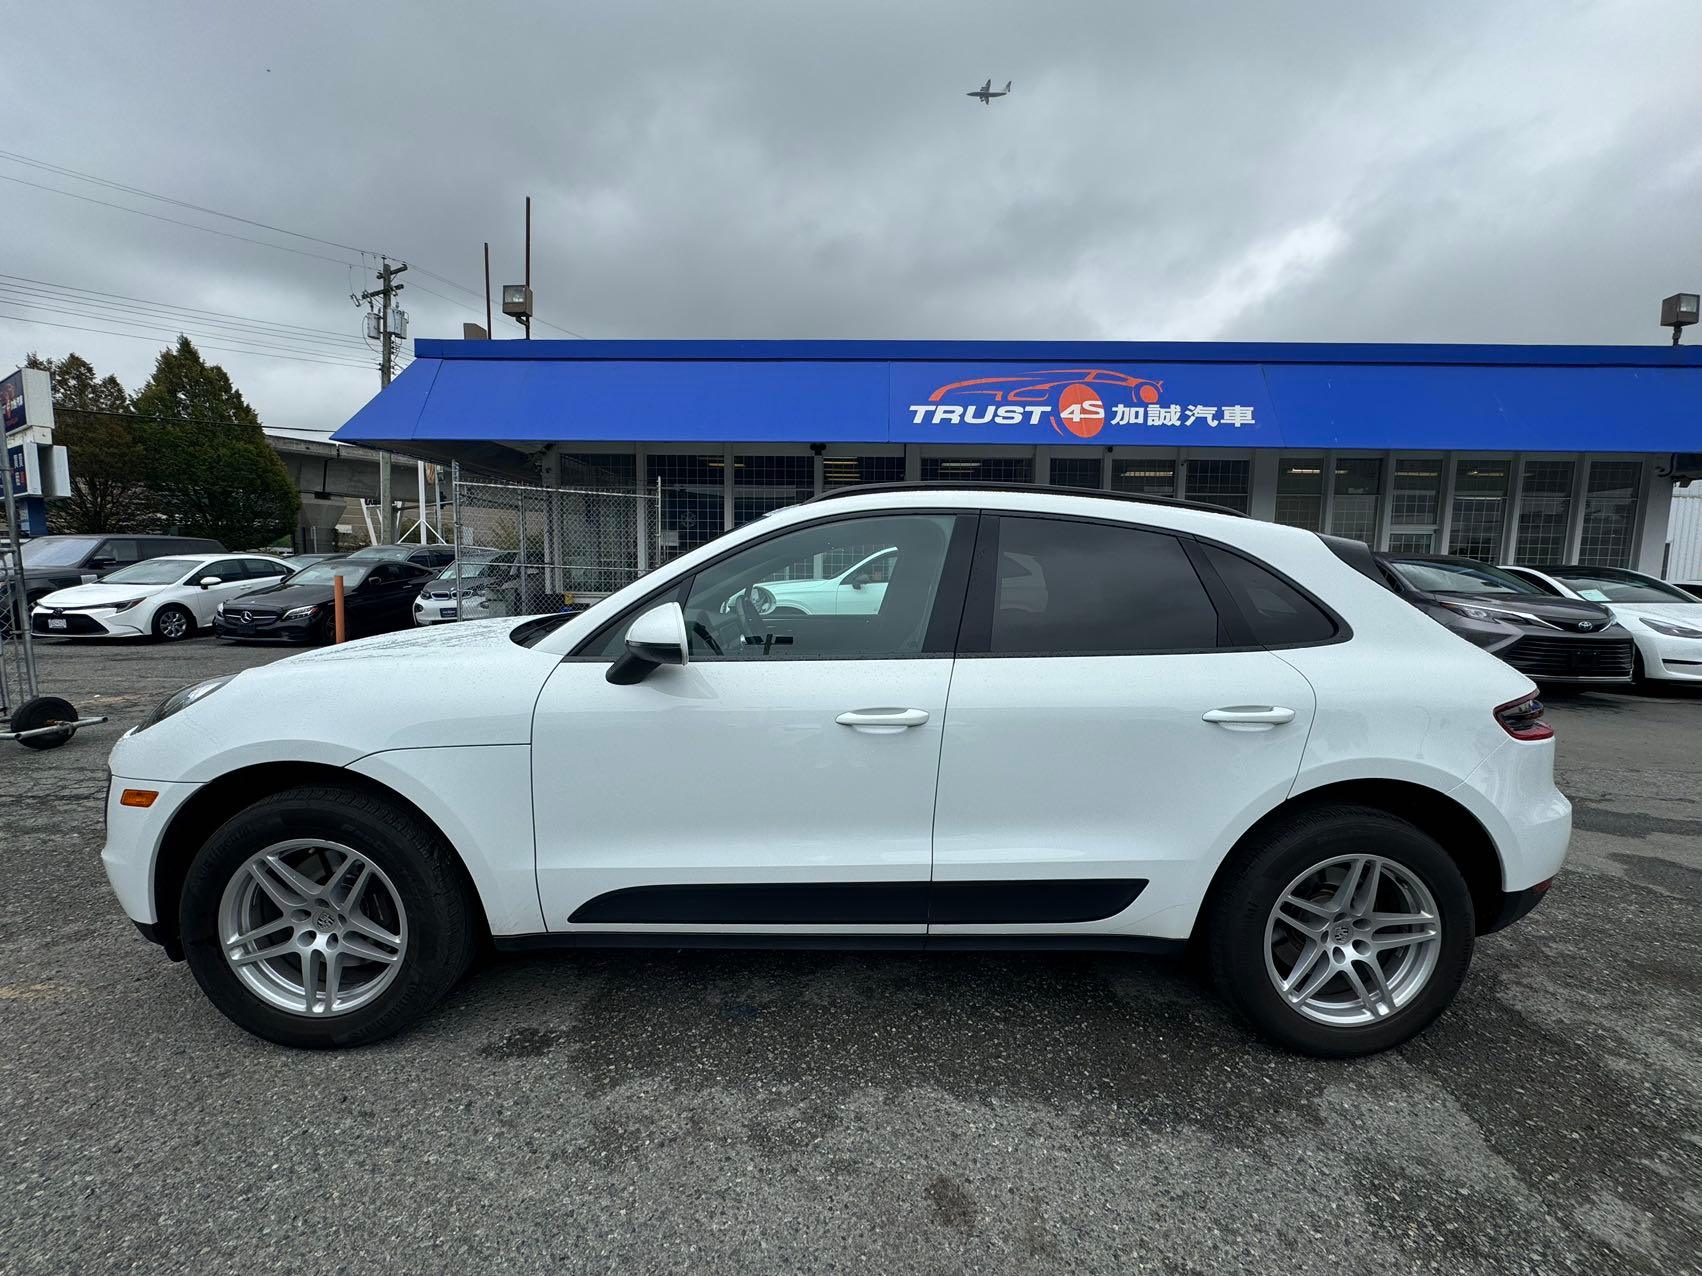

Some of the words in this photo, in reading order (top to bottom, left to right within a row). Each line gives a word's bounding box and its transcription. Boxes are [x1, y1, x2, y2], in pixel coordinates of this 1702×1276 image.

[908, 405, 1052, 425] TRUST
[1059, 400, 1105, 422] 4S
[1110, 403, 1256, 428] 加誠汽車
